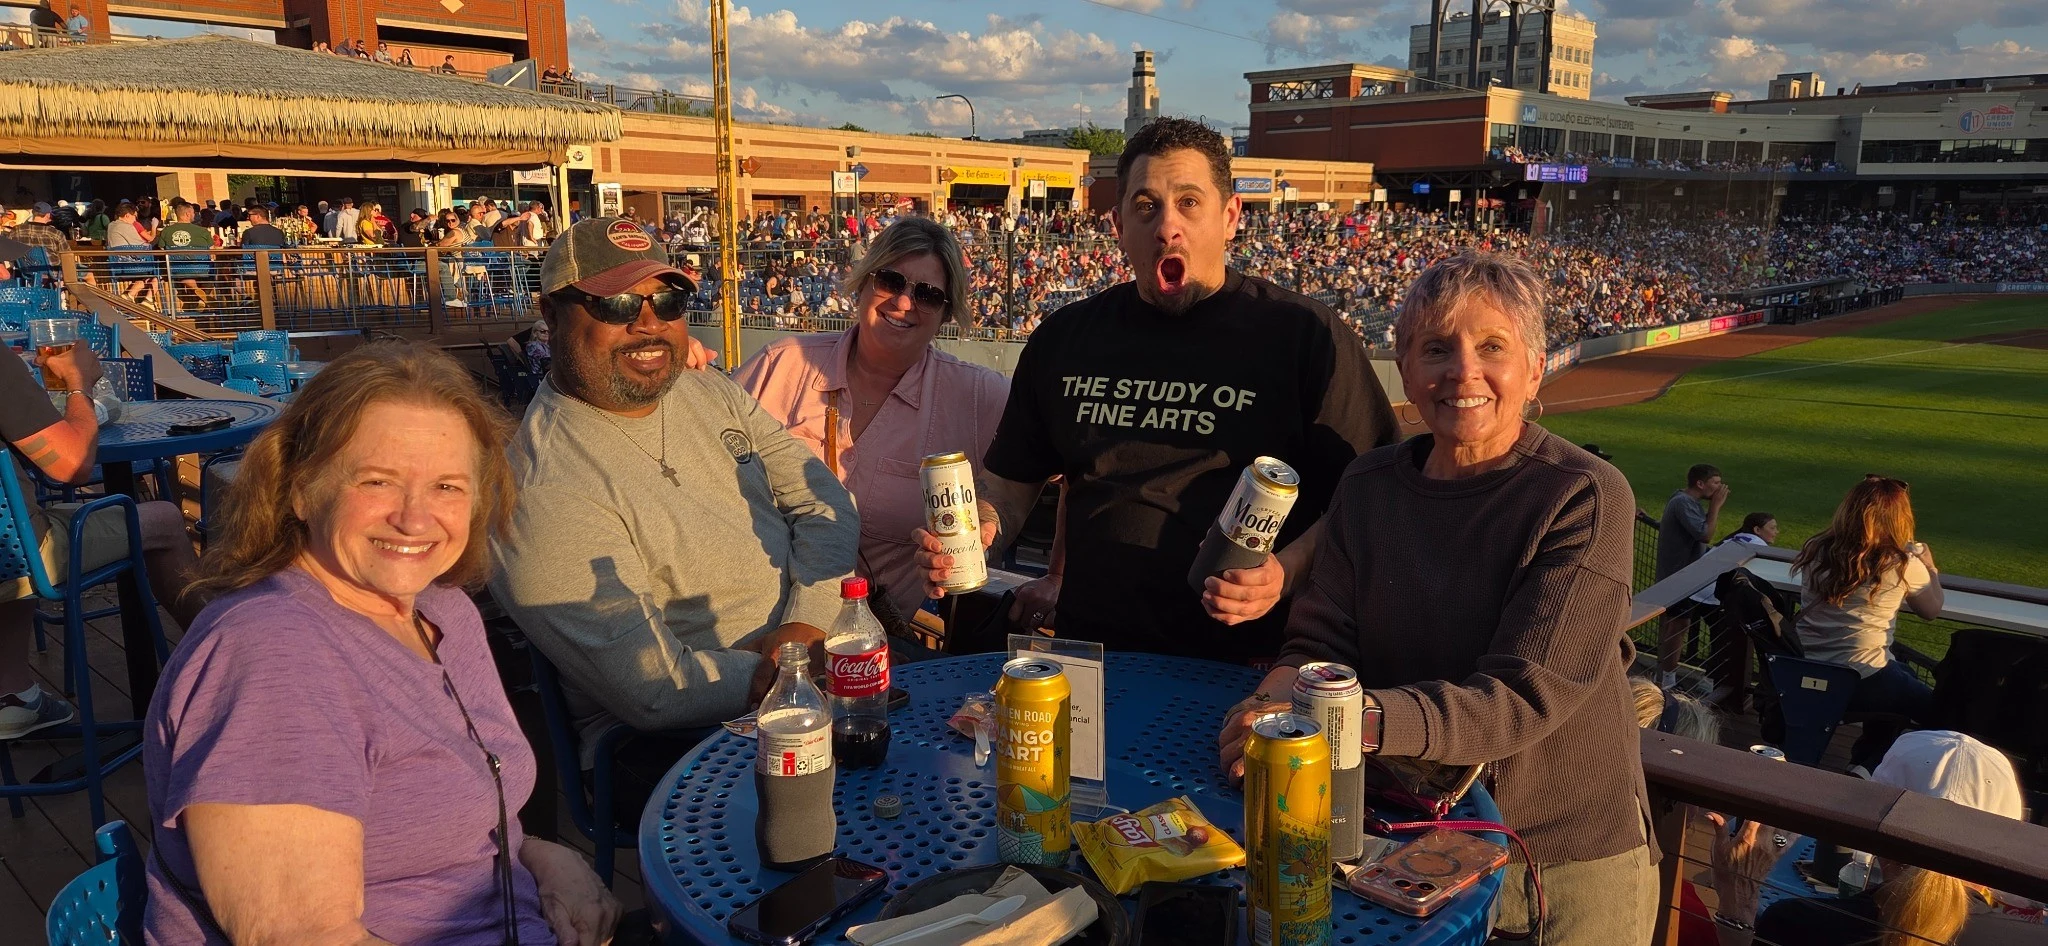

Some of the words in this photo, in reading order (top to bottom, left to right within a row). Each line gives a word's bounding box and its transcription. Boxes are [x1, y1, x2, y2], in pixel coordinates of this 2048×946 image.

[1062, 376, 1110, 397] THE
[1113, 379, 1207, 403] STUDY
[1212, 385, 1257, 411] OF
[1076, 402, 1136, 427] FINE
[1139, 407, 1216, 435] ARTS
[1234, 497, 1286, 534] Model
[1024, 710, 1052, 723] ROAD
[1000, 725, 1054, 745] ANGO
[1112, 816, 1153, 845] Lay's
